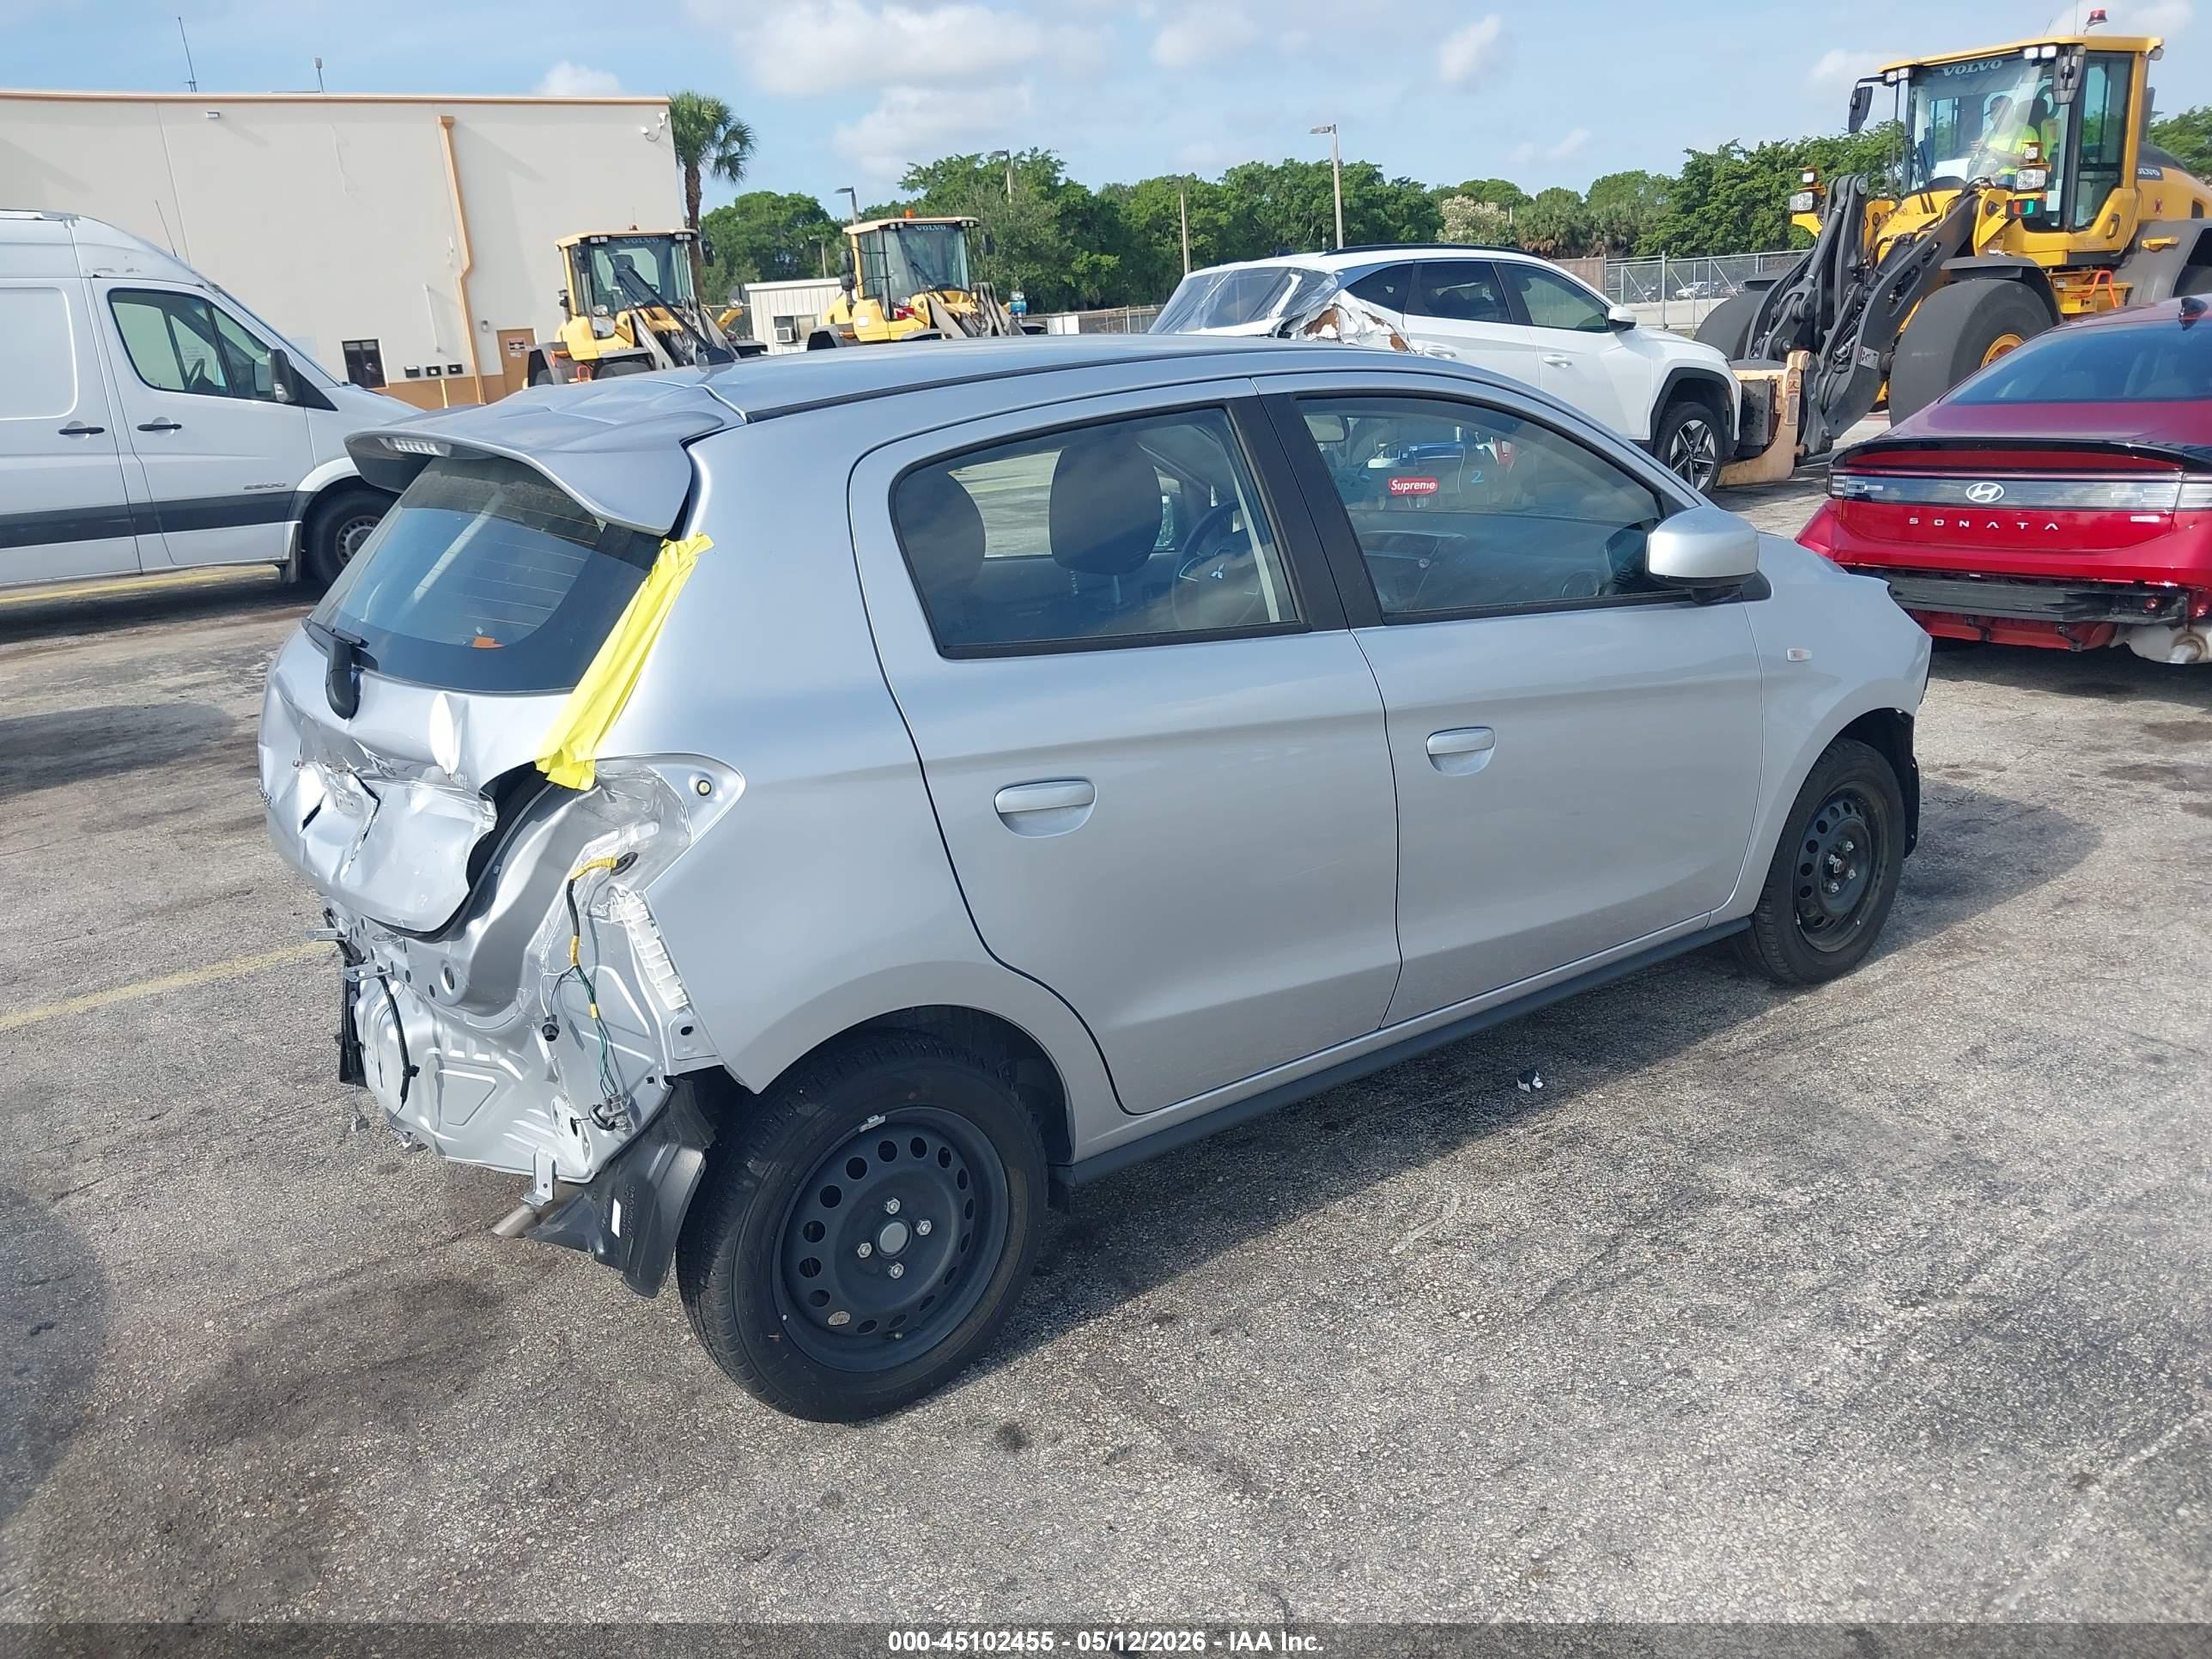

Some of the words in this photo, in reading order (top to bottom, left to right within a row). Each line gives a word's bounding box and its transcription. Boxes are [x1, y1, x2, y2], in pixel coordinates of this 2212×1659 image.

[1942, 59, 2003, 76] VOLVO
[1391, 479, 1436, 493] Supreme
[1909, 517, 2059, 531] SONATA
